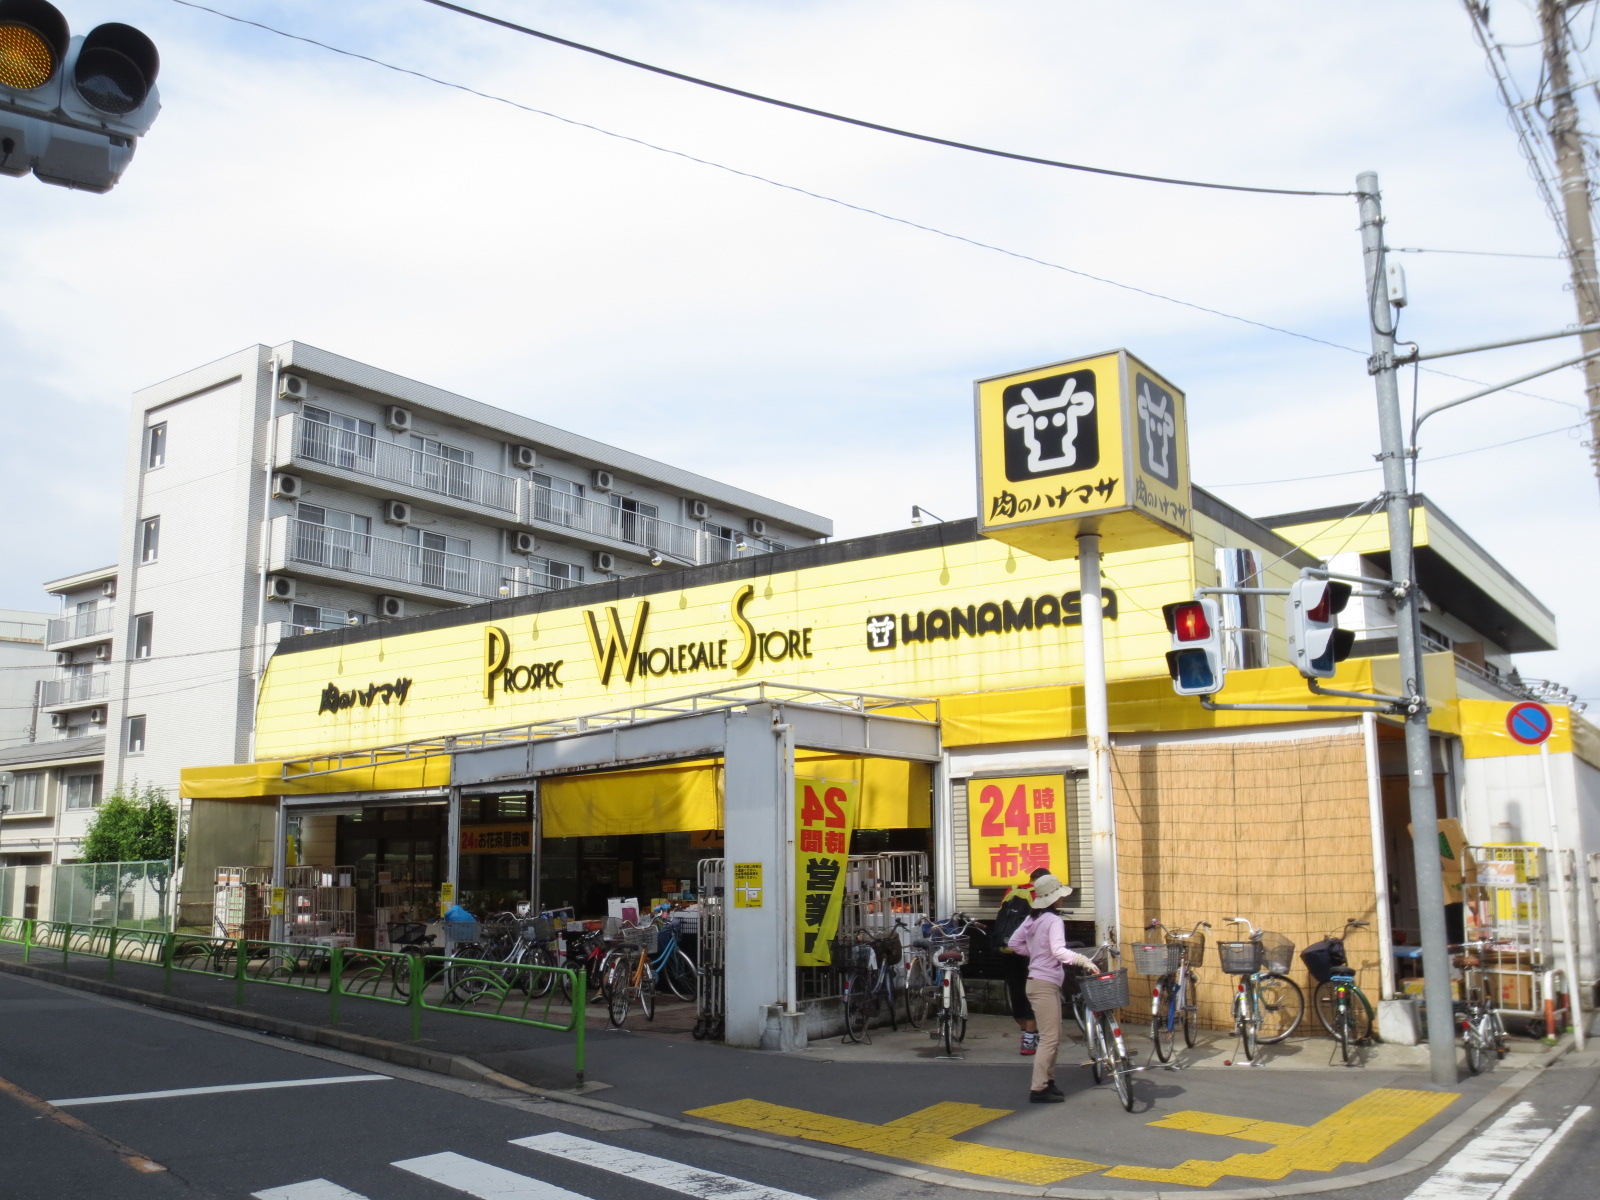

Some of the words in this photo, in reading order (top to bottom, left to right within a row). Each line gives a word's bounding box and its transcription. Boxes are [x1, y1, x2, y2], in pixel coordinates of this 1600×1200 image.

[990, 477, 1119, 521] 肉のハナマサ
[1135, 474, 1187, 527] 肉のハナマサ
[901, 588, 1118, 645] HANAMASA
[483, 626, 564, 704] PROSPEC
[582, 601, 728, 687] WHOLESALE
[731, 584, 813, 673] STORE
[989, 843, 1050, 878] 市場
